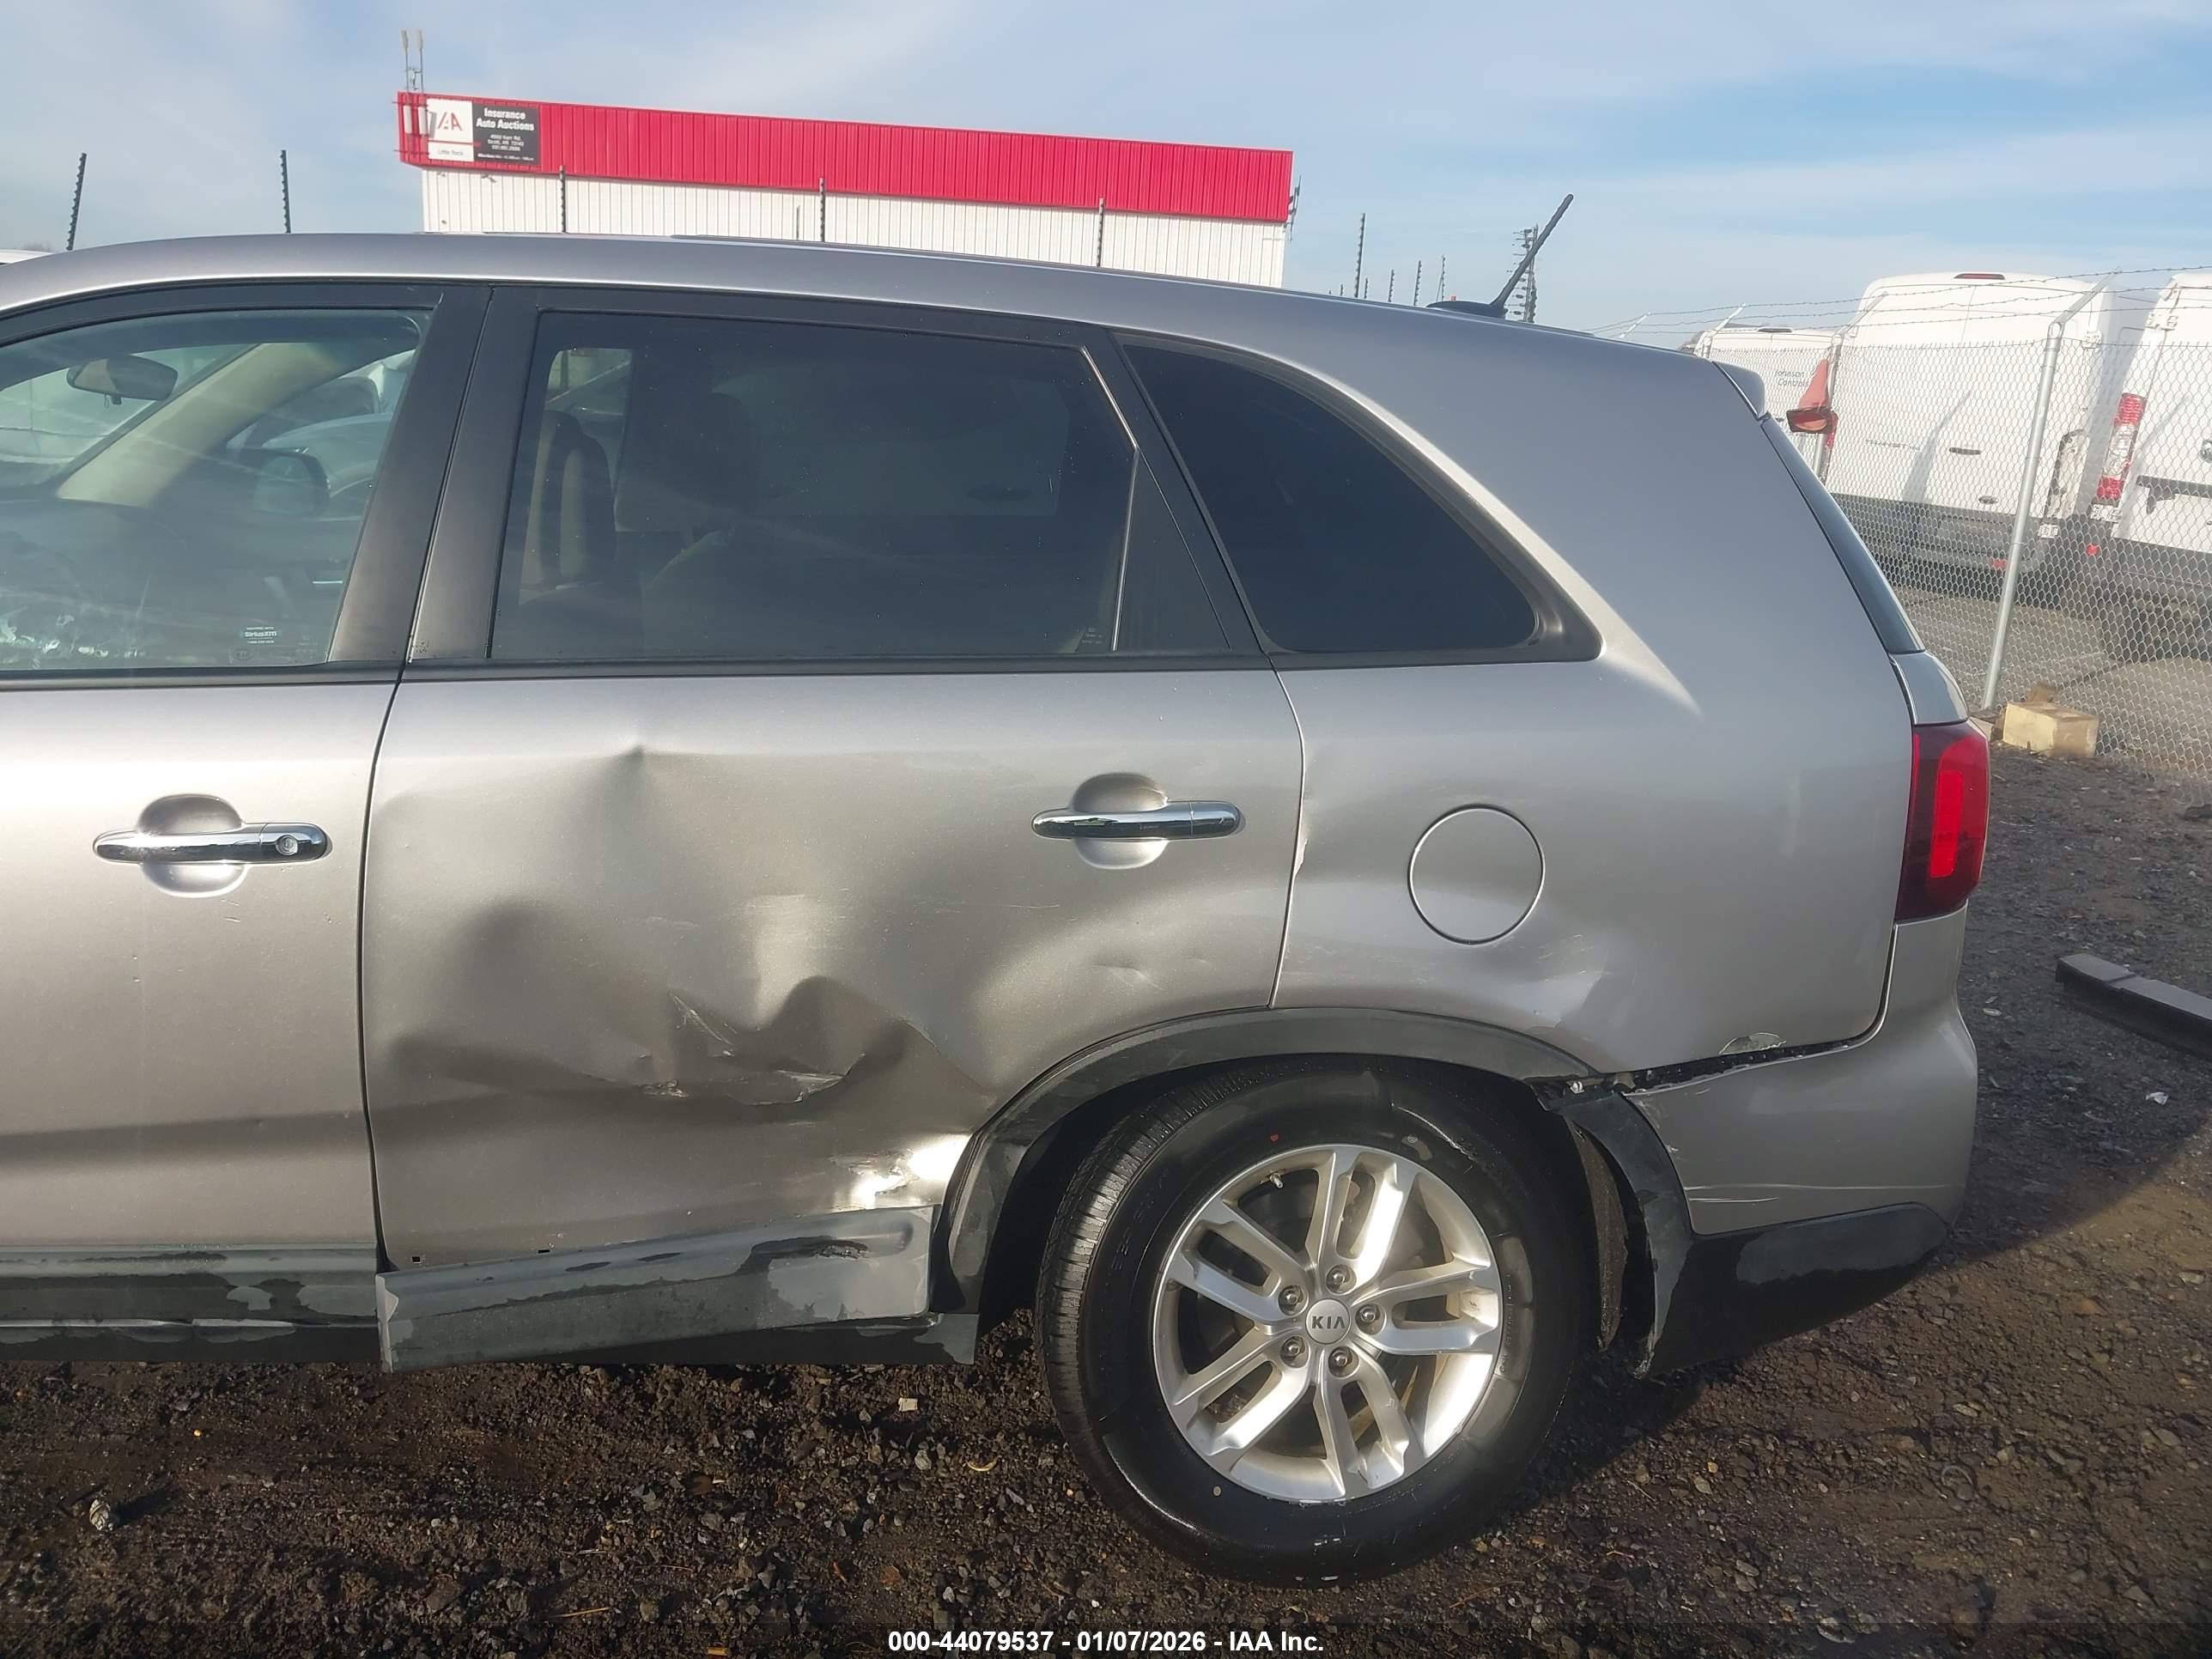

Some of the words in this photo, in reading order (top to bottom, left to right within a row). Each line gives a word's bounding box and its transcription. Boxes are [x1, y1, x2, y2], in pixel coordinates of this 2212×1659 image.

[483, 107, 526, 119] Insurance
[476, 117, 496, 128] Auto
[497, 118, 535, 131] Auctions
[1311, 1316, 1346, 1329] KIA
